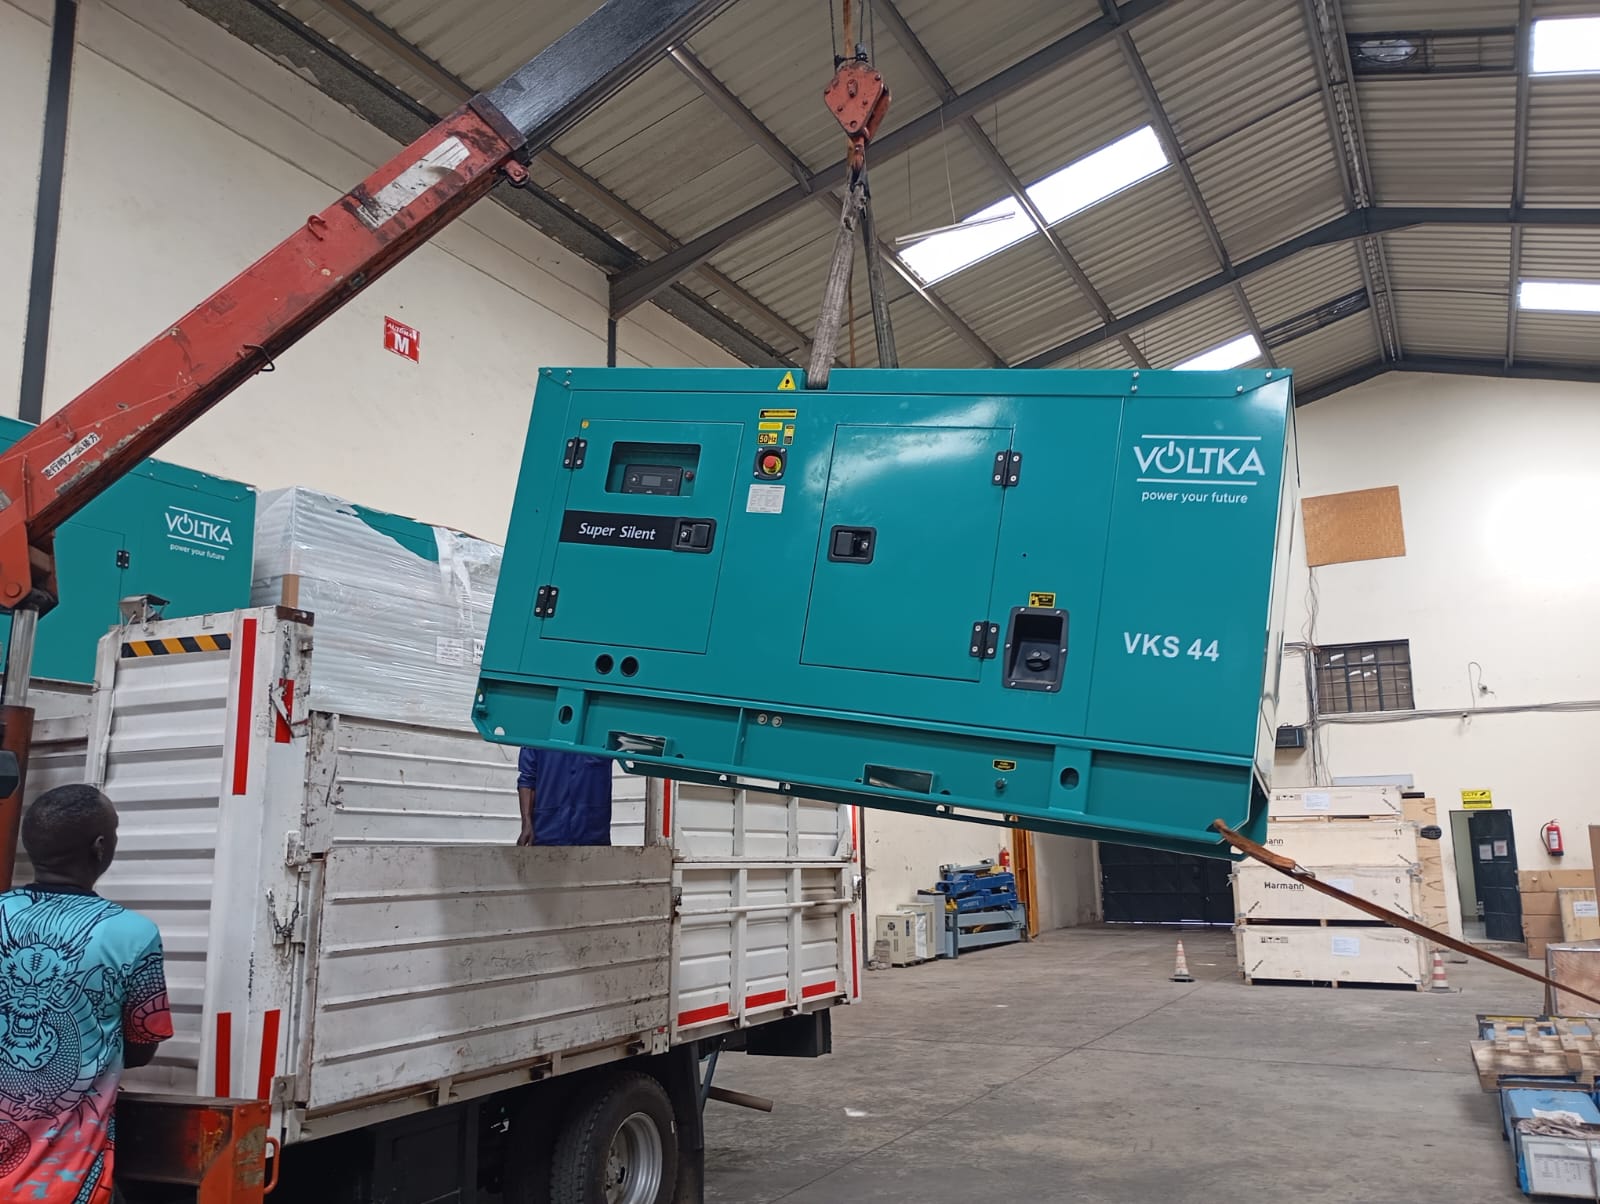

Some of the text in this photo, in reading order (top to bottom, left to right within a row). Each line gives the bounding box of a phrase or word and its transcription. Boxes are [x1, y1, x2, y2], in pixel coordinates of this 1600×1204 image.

[394, 332, 410, 355] M
[1133, 440, 1266, 476] VOLTKA
[1141, 491, 1248, 504] power your future
[164, 512, 233, 545] VOLTKA
[578, 522, 656, 540] Super Silent
[169, 543, 225, 561] power your future
[1123, 631, 1220, 662] VKS 44
[1263, 881, 1305, 890] Harmann
